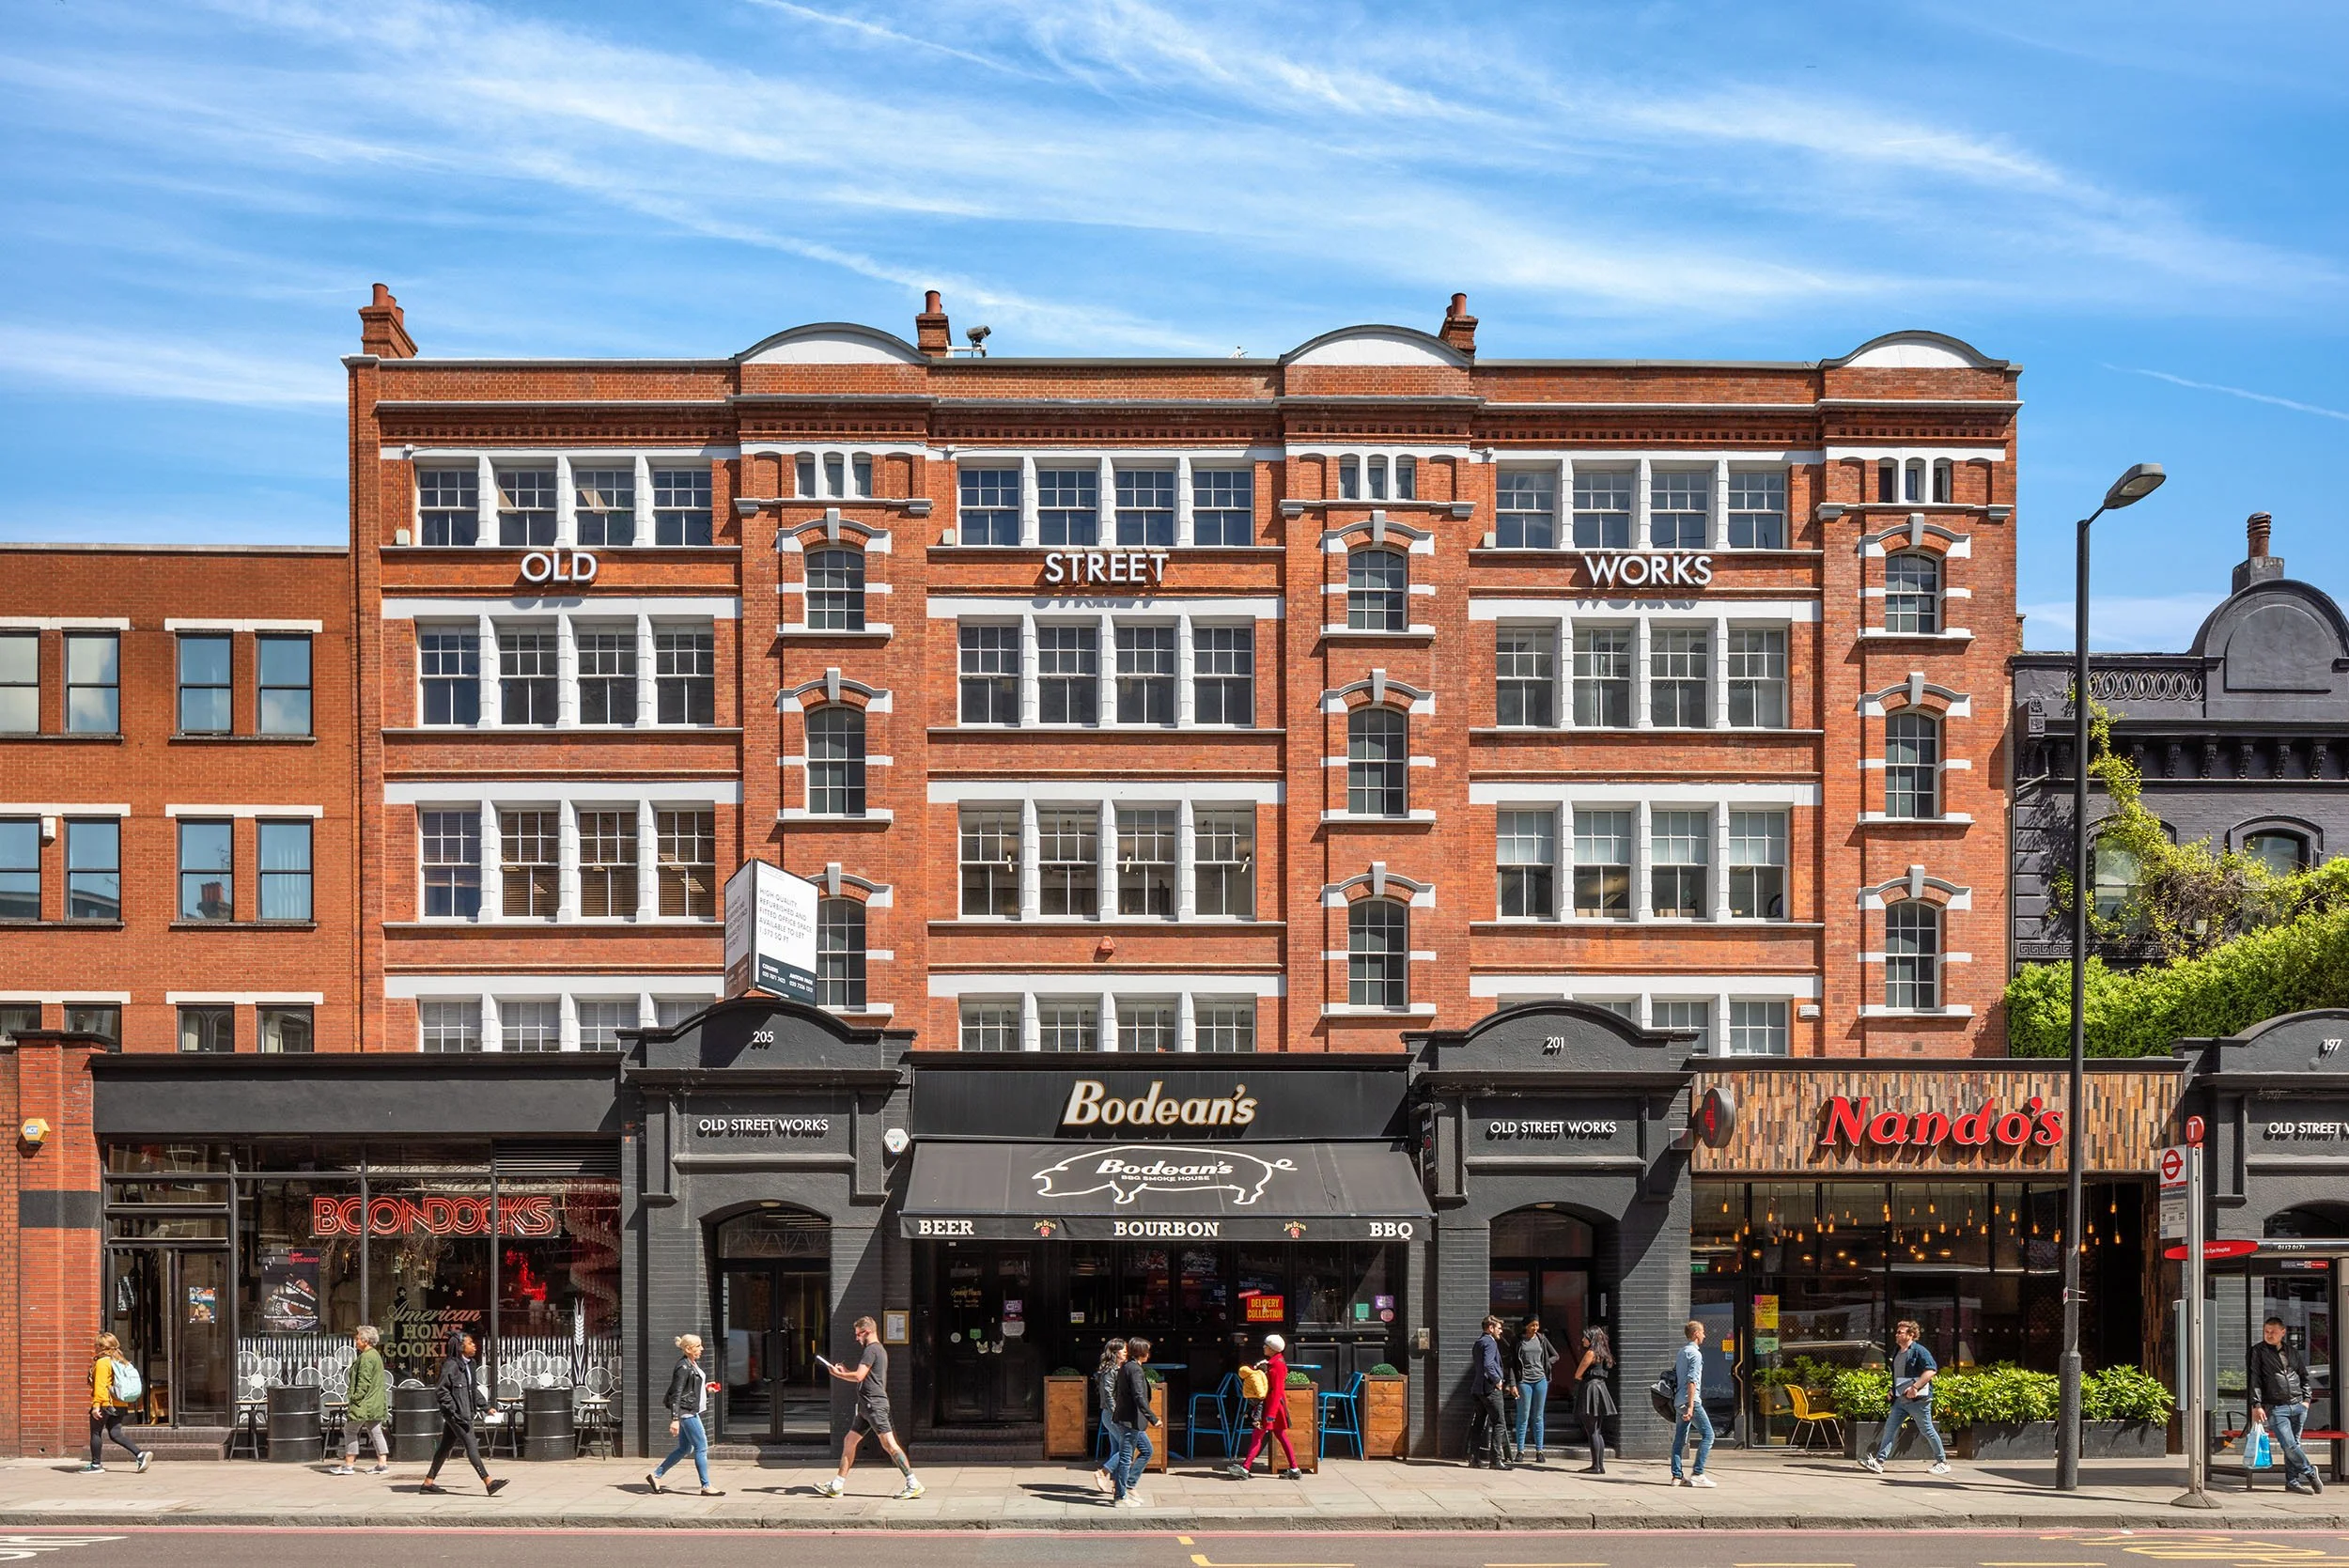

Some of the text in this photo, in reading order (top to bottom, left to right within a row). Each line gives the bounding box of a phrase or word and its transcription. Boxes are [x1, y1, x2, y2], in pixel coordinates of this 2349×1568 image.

[521, 551, 1714, 587] OLD STREET WORKS
[753, 1031, 774, 1043] 205
[1546, 1036, 1565, 1049] 201
[2324, 1038, 2342, 1050] 197
[1063, 1080, 1258, 1125] Bodean's
[699, 1118, 829, 1131] OLD STREET WORKS
[1489, 1121, 1617, 1133] OLD STREET WORKS
[1821, 1096, 2064, 1146] Nando's
[2268, 1122, 2295, 1134] OLD
[2298, 1122, 2341, 1134] STREET
[2188, 1121, 2198, 1139] T
[1096, 1159, 1234, 1176] Bodean's
[313, 1197, 554, 1235] BOONDOCKS
[918, 1219, 974, 1235] BEER
[1113, 1221, 1220, 1236] BOURBON
[1369, 1222, 1413, 1239] BBQ
[381, 1300, 482, 1322] American
[1251, 1298, 1280, 1308] DELIVERY
[1247, 1310, 1283, 1318] COLLECTION
[383, 1342, 447, 1358] COOKI
